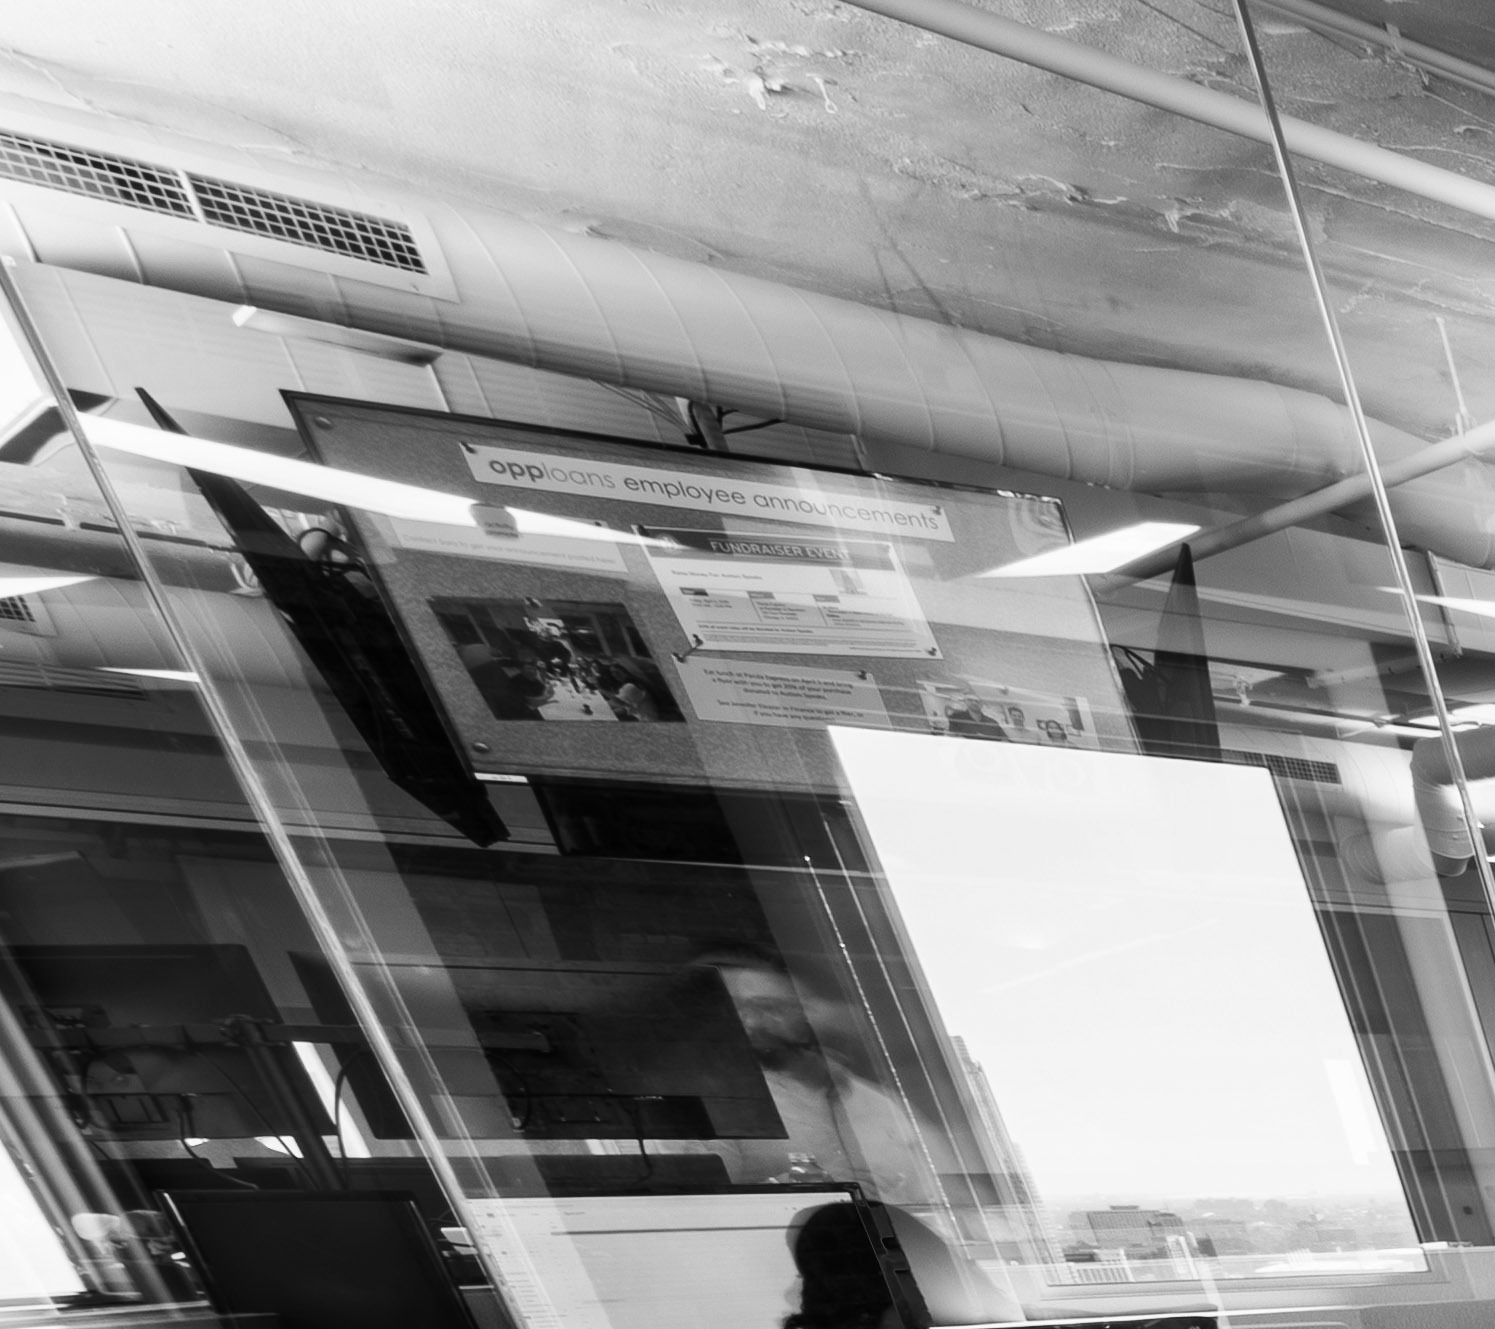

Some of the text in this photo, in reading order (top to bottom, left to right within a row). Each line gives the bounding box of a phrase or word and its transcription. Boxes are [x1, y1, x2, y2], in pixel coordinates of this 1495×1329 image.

[489, 457, 939, 530] opploans employee announcements
[709, 541, 849, 560] FUNDRAISER EVENT
